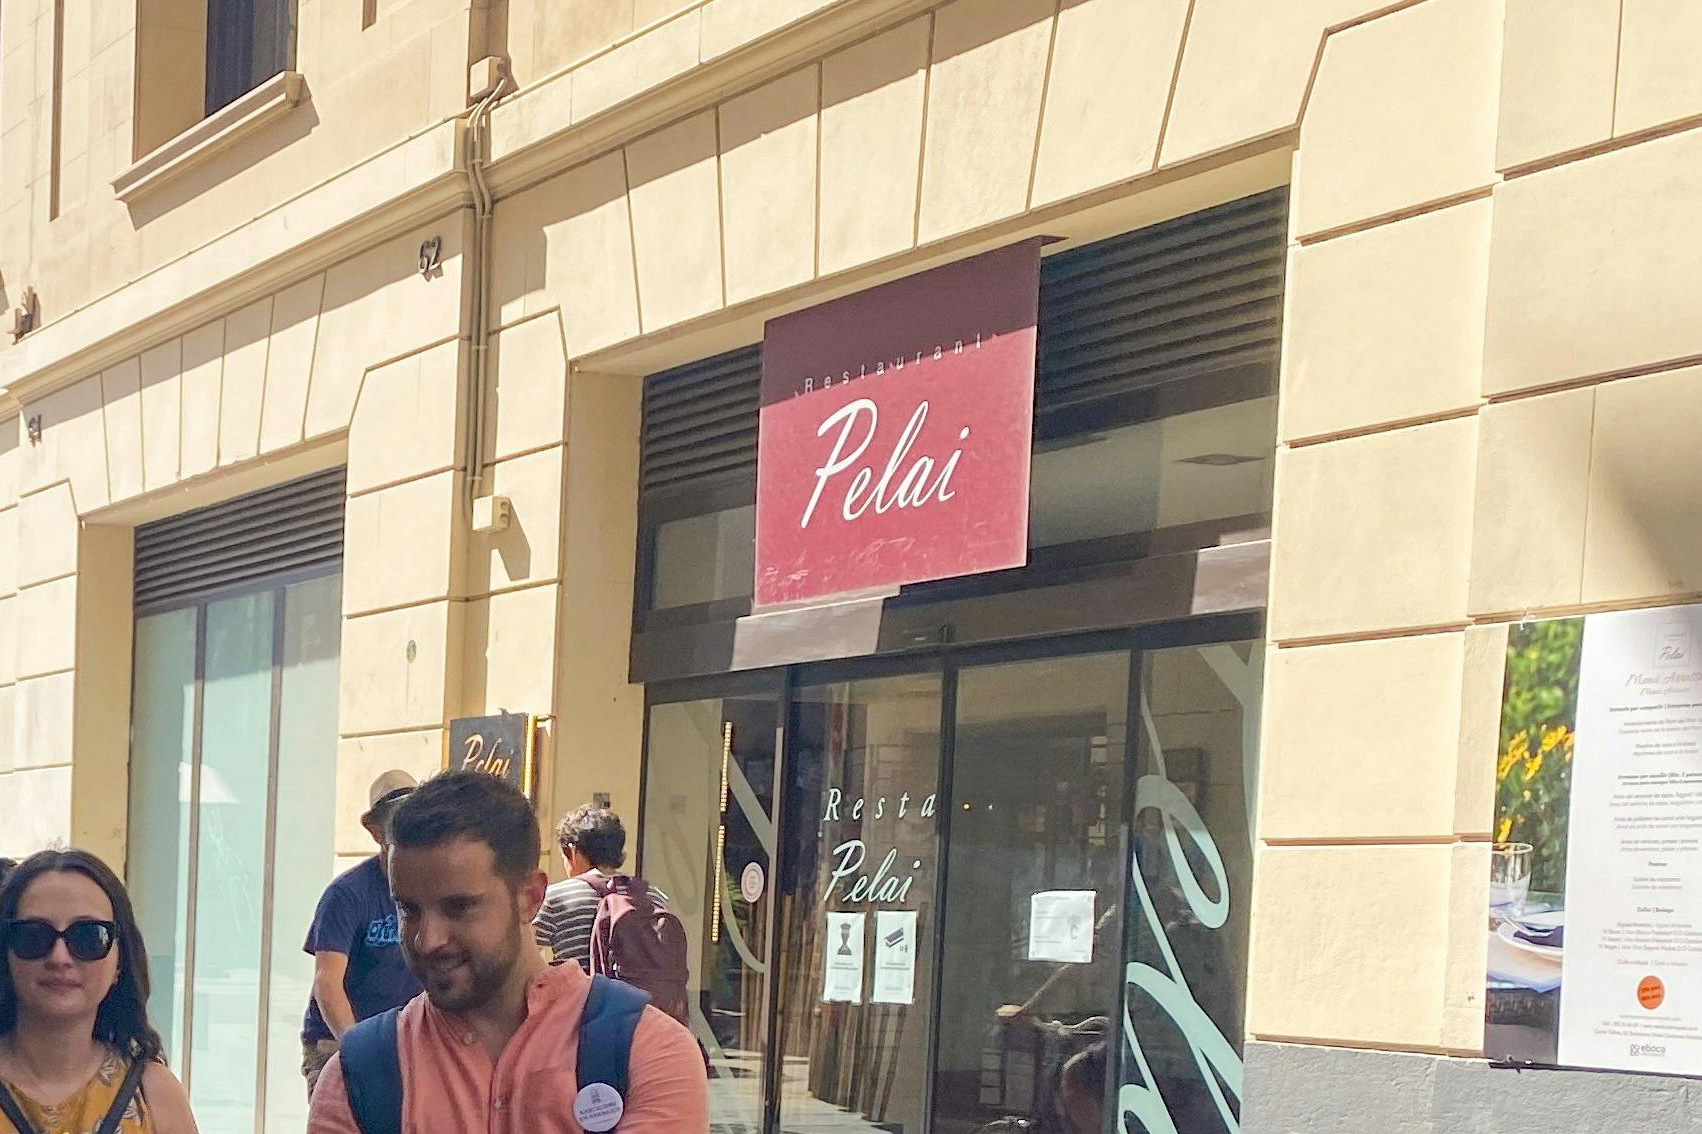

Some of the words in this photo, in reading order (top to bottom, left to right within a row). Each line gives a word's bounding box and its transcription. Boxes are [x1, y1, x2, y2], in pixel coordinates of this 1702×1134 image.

[803, 333, 983, 394] Restaurant
[800, 397, 971, 530] Pelai
[822, 838, 922, 904] Pelai
